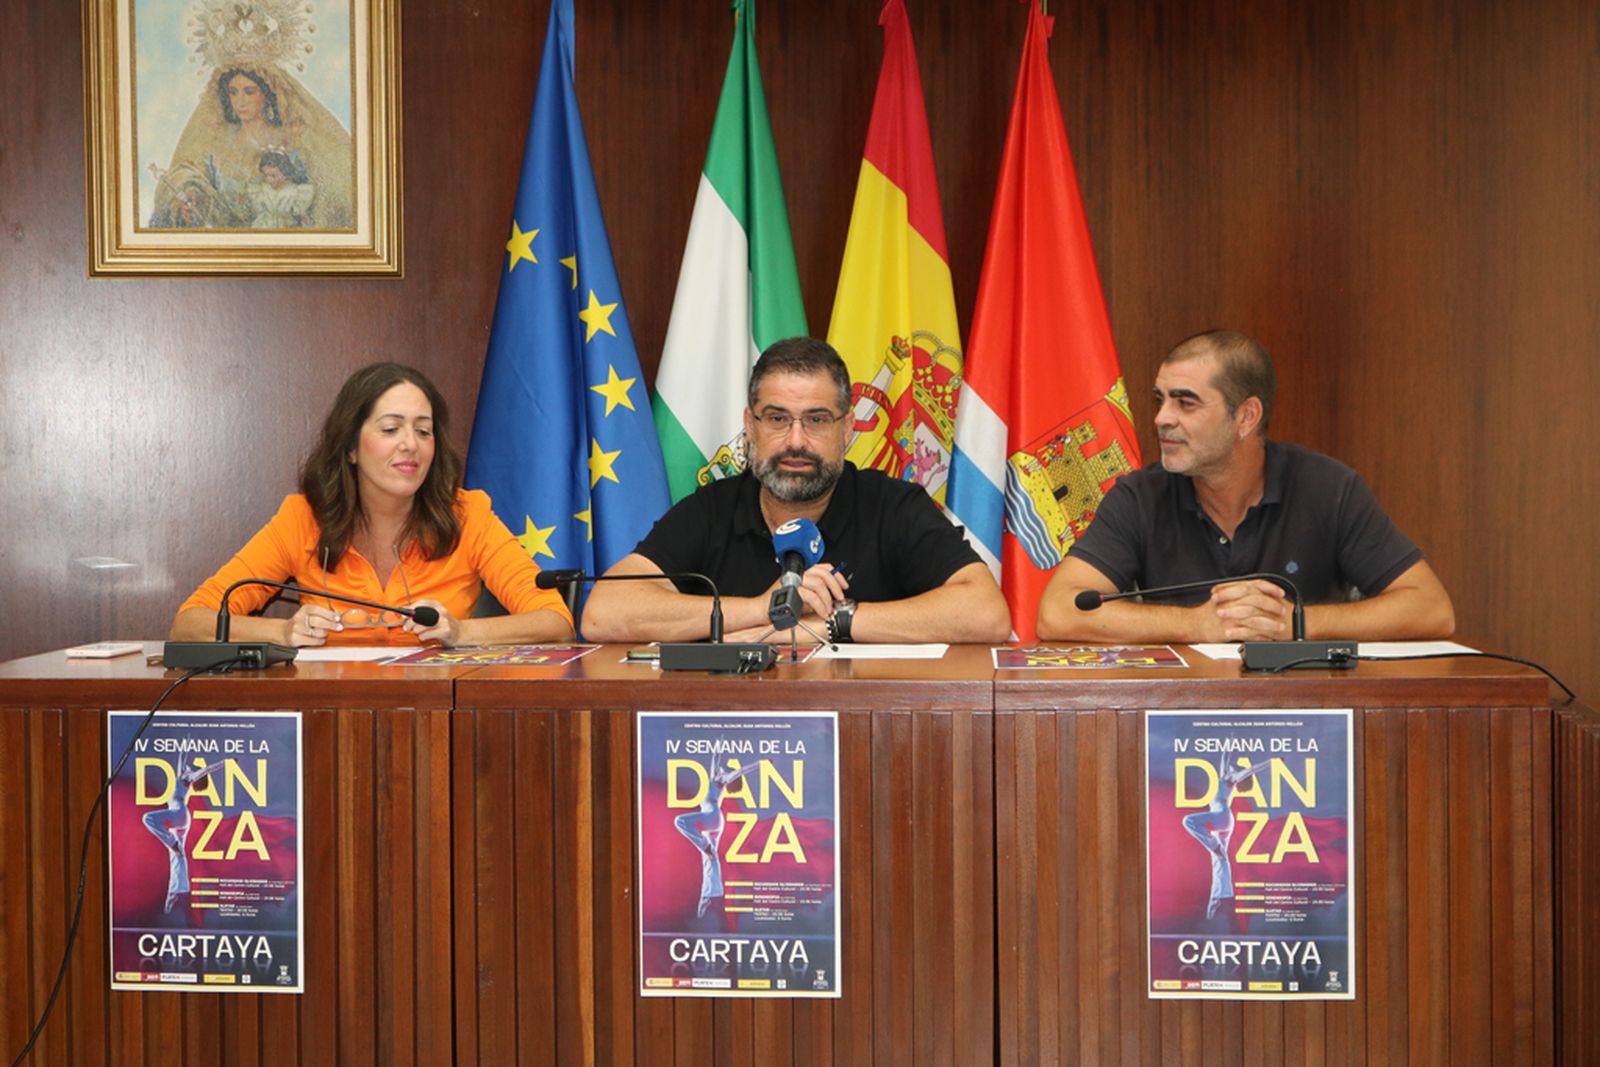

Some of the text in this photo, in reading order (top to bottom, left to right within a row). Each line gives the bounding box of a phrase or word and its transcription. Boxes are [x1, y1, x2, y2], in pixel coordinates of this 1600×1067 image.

[135, 738, 270, 753] IV SEMANA DE LA
[666, 740, 806, 754] IV SEMANA DE LA
[1174, 738, 1318, 752] IV SEMANA DE LA
[192, 810, 270, 860] ZA
[725, 812, 807, 863] ZA
[1235, 812, 1320, 863] ZA
[138, 934, 273, 959] CARTAYA
[669, 939, 809, 963] CARTAYA
[1178, 940, 1321, 965] CARTAYA
